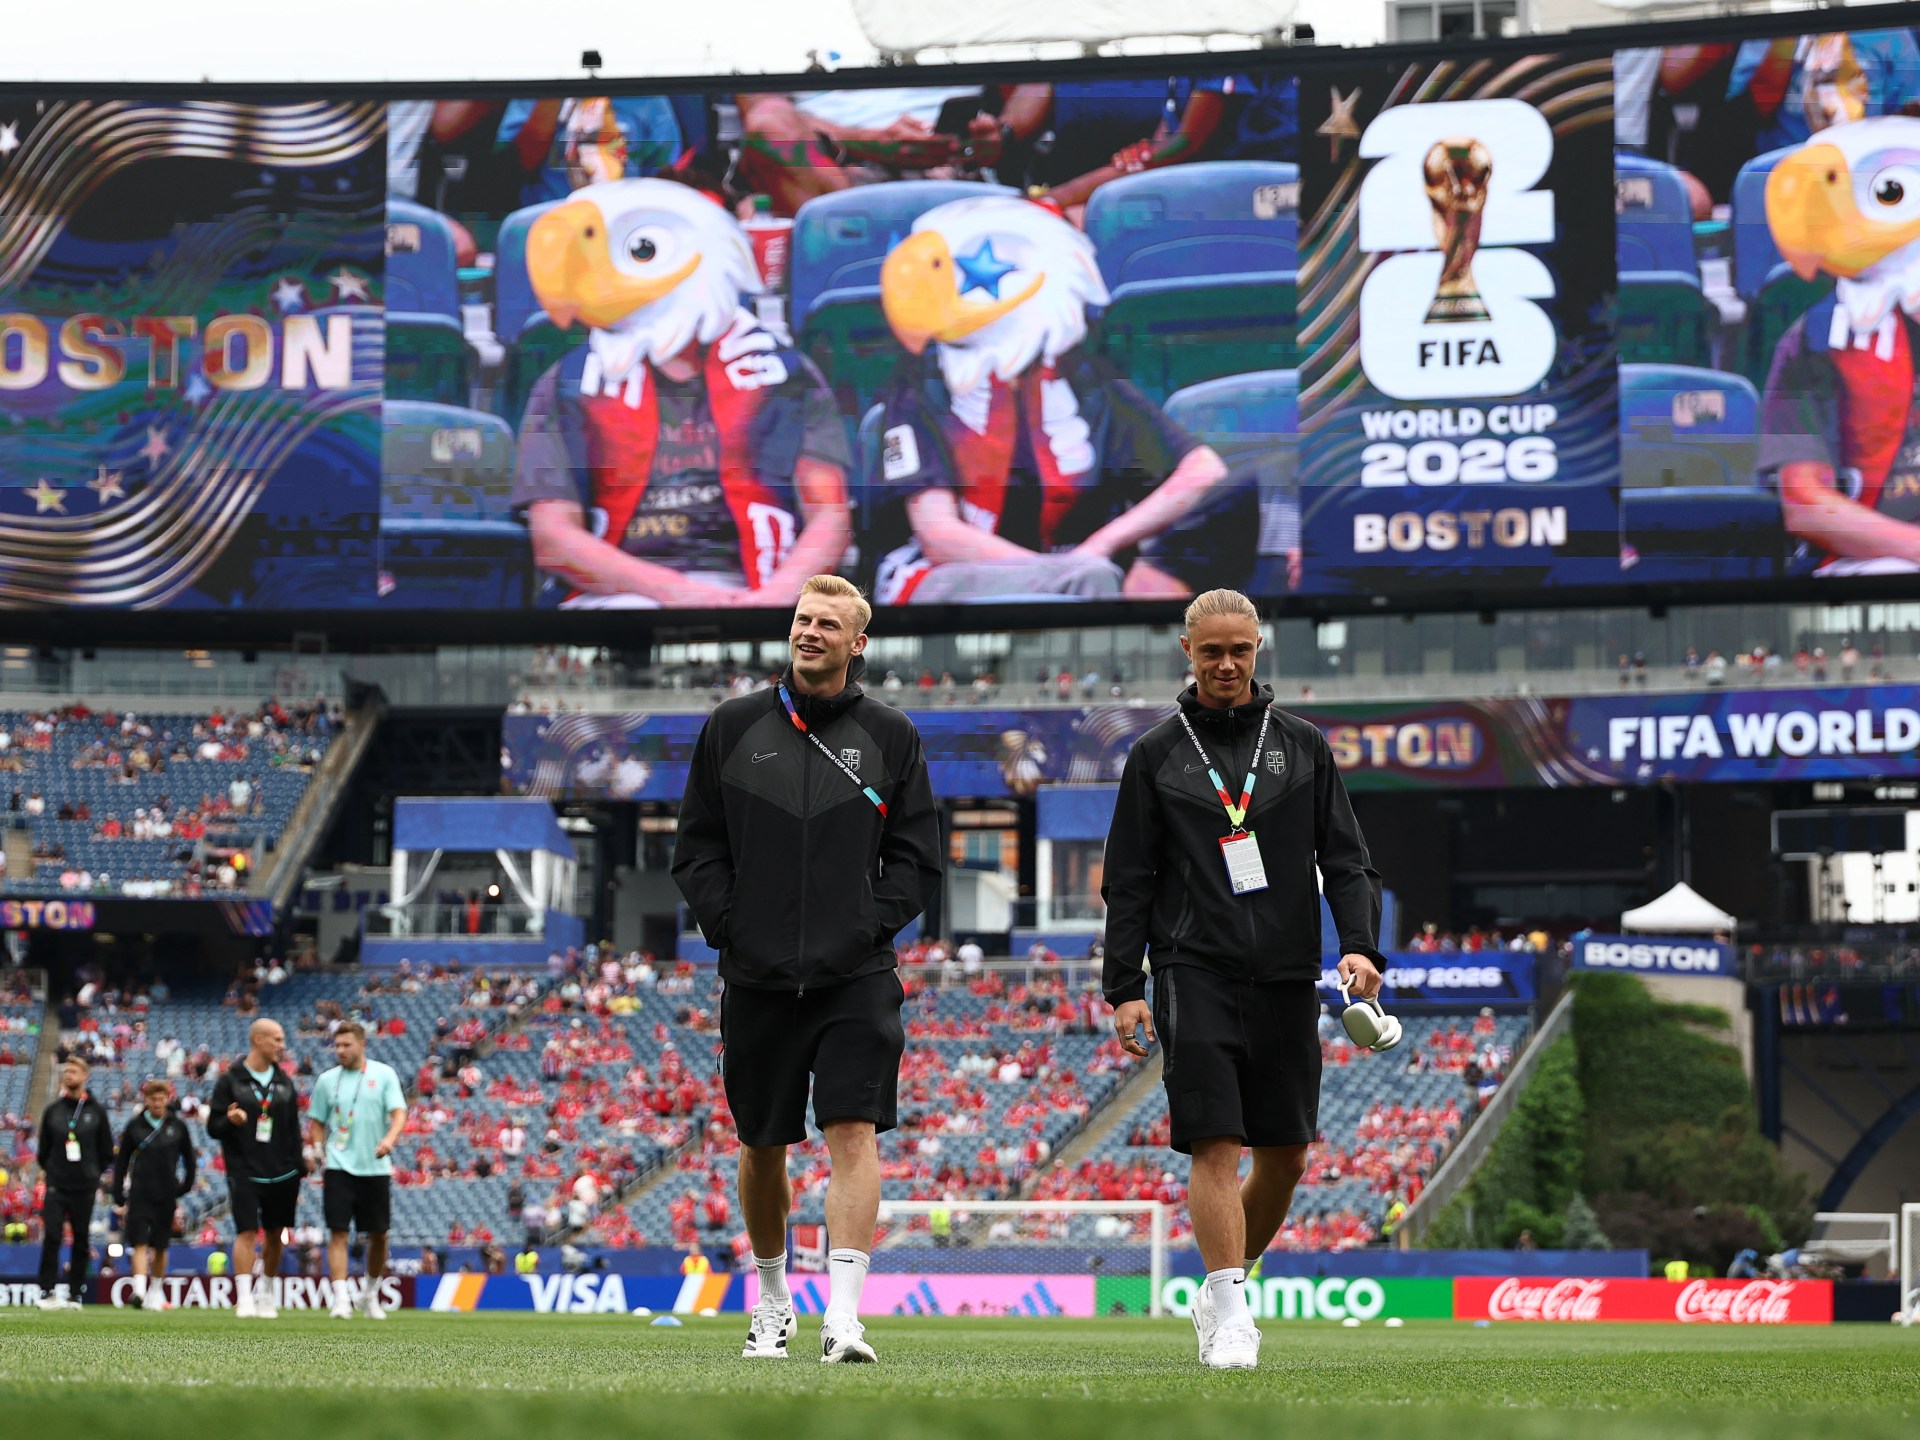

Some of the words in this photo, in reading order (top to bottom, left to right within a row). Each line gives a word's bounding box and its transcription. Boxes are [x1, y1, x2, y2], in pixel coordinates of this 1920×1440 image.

[1419, 339, 1501, 367] FIFA
[1360, 407, 1485, 440] WORLD
[1487, 403, 1557, 434] CUP
[1360, 436, 1558, 488] 2026
[1353, 506, 1567, 553] BOSTON
[1260, 719, 1269, 737] WORLD
[1609, 714, 1724, 761] FIFA
[1727, 707, 1920, 757] WORLD
[808, 733, 820, 746] FIFA
[818, 742, 836, 761] WORLD
[834, 758, 846, 769] CUP
[843, 766, 862, 785] 2026
[1191, 735, 1205, 755] WORLD
[1251, 748, 1261, 768] 2026
[1584, 942, 1720, 971] BOSTON
[1427, 966, 1503, 989] 2026
[519, 1273, 628, 1313] VISA
